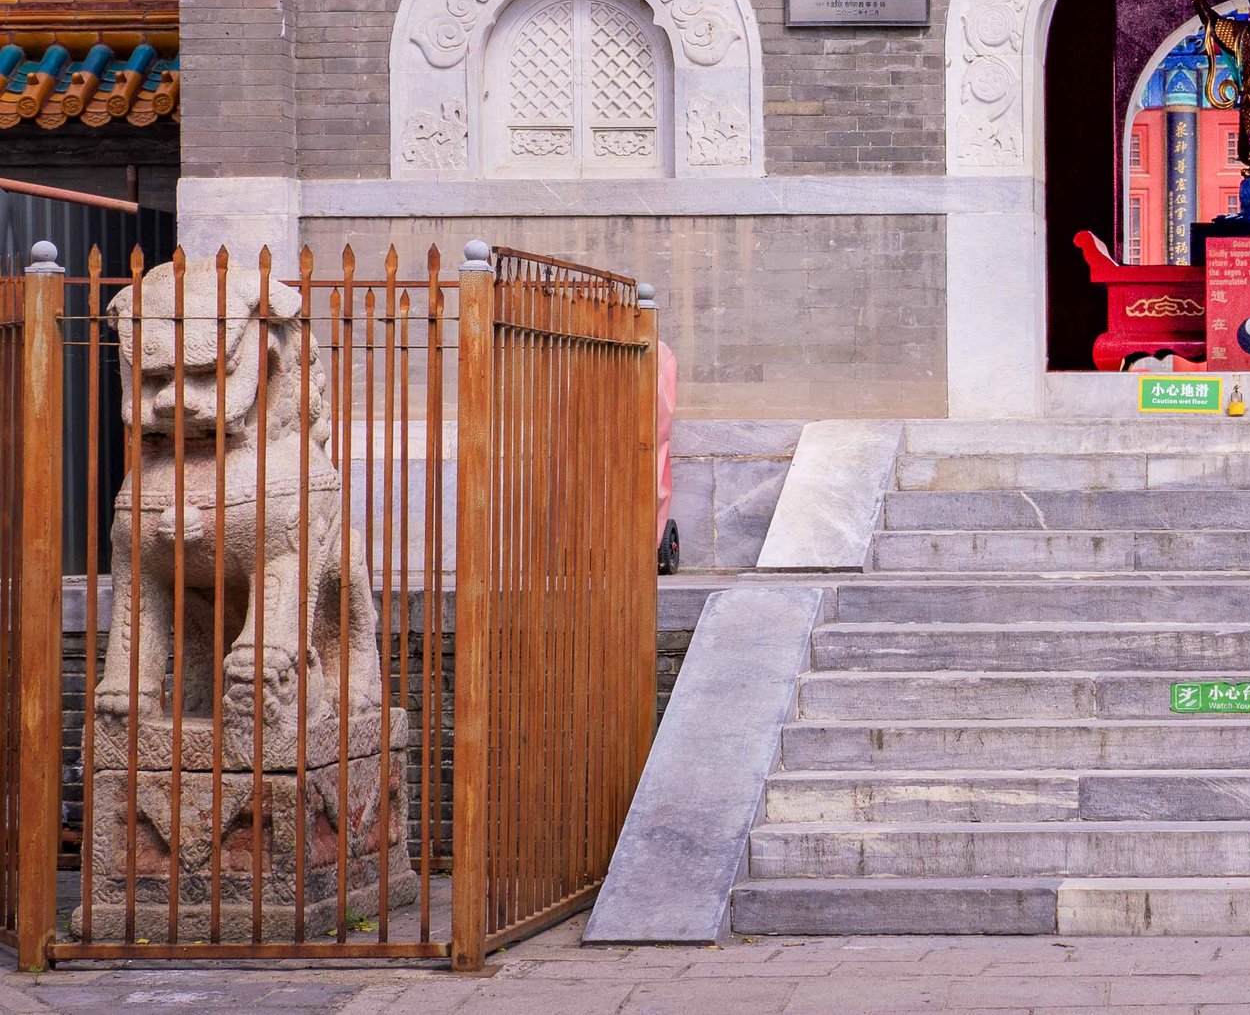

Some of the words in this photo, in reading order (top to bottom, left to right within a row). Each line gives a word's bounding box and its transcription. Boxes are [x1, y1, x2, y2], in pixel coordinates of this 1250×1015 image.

[1208, 249, 1228, 258] Kindly
[1209, 268, 1220, 276] the
[1209, 277, 1248, 286] accumulated
[1151, 382, 1210, 398] 小心地滑
[1151, 397, 1178, 405] Caution
